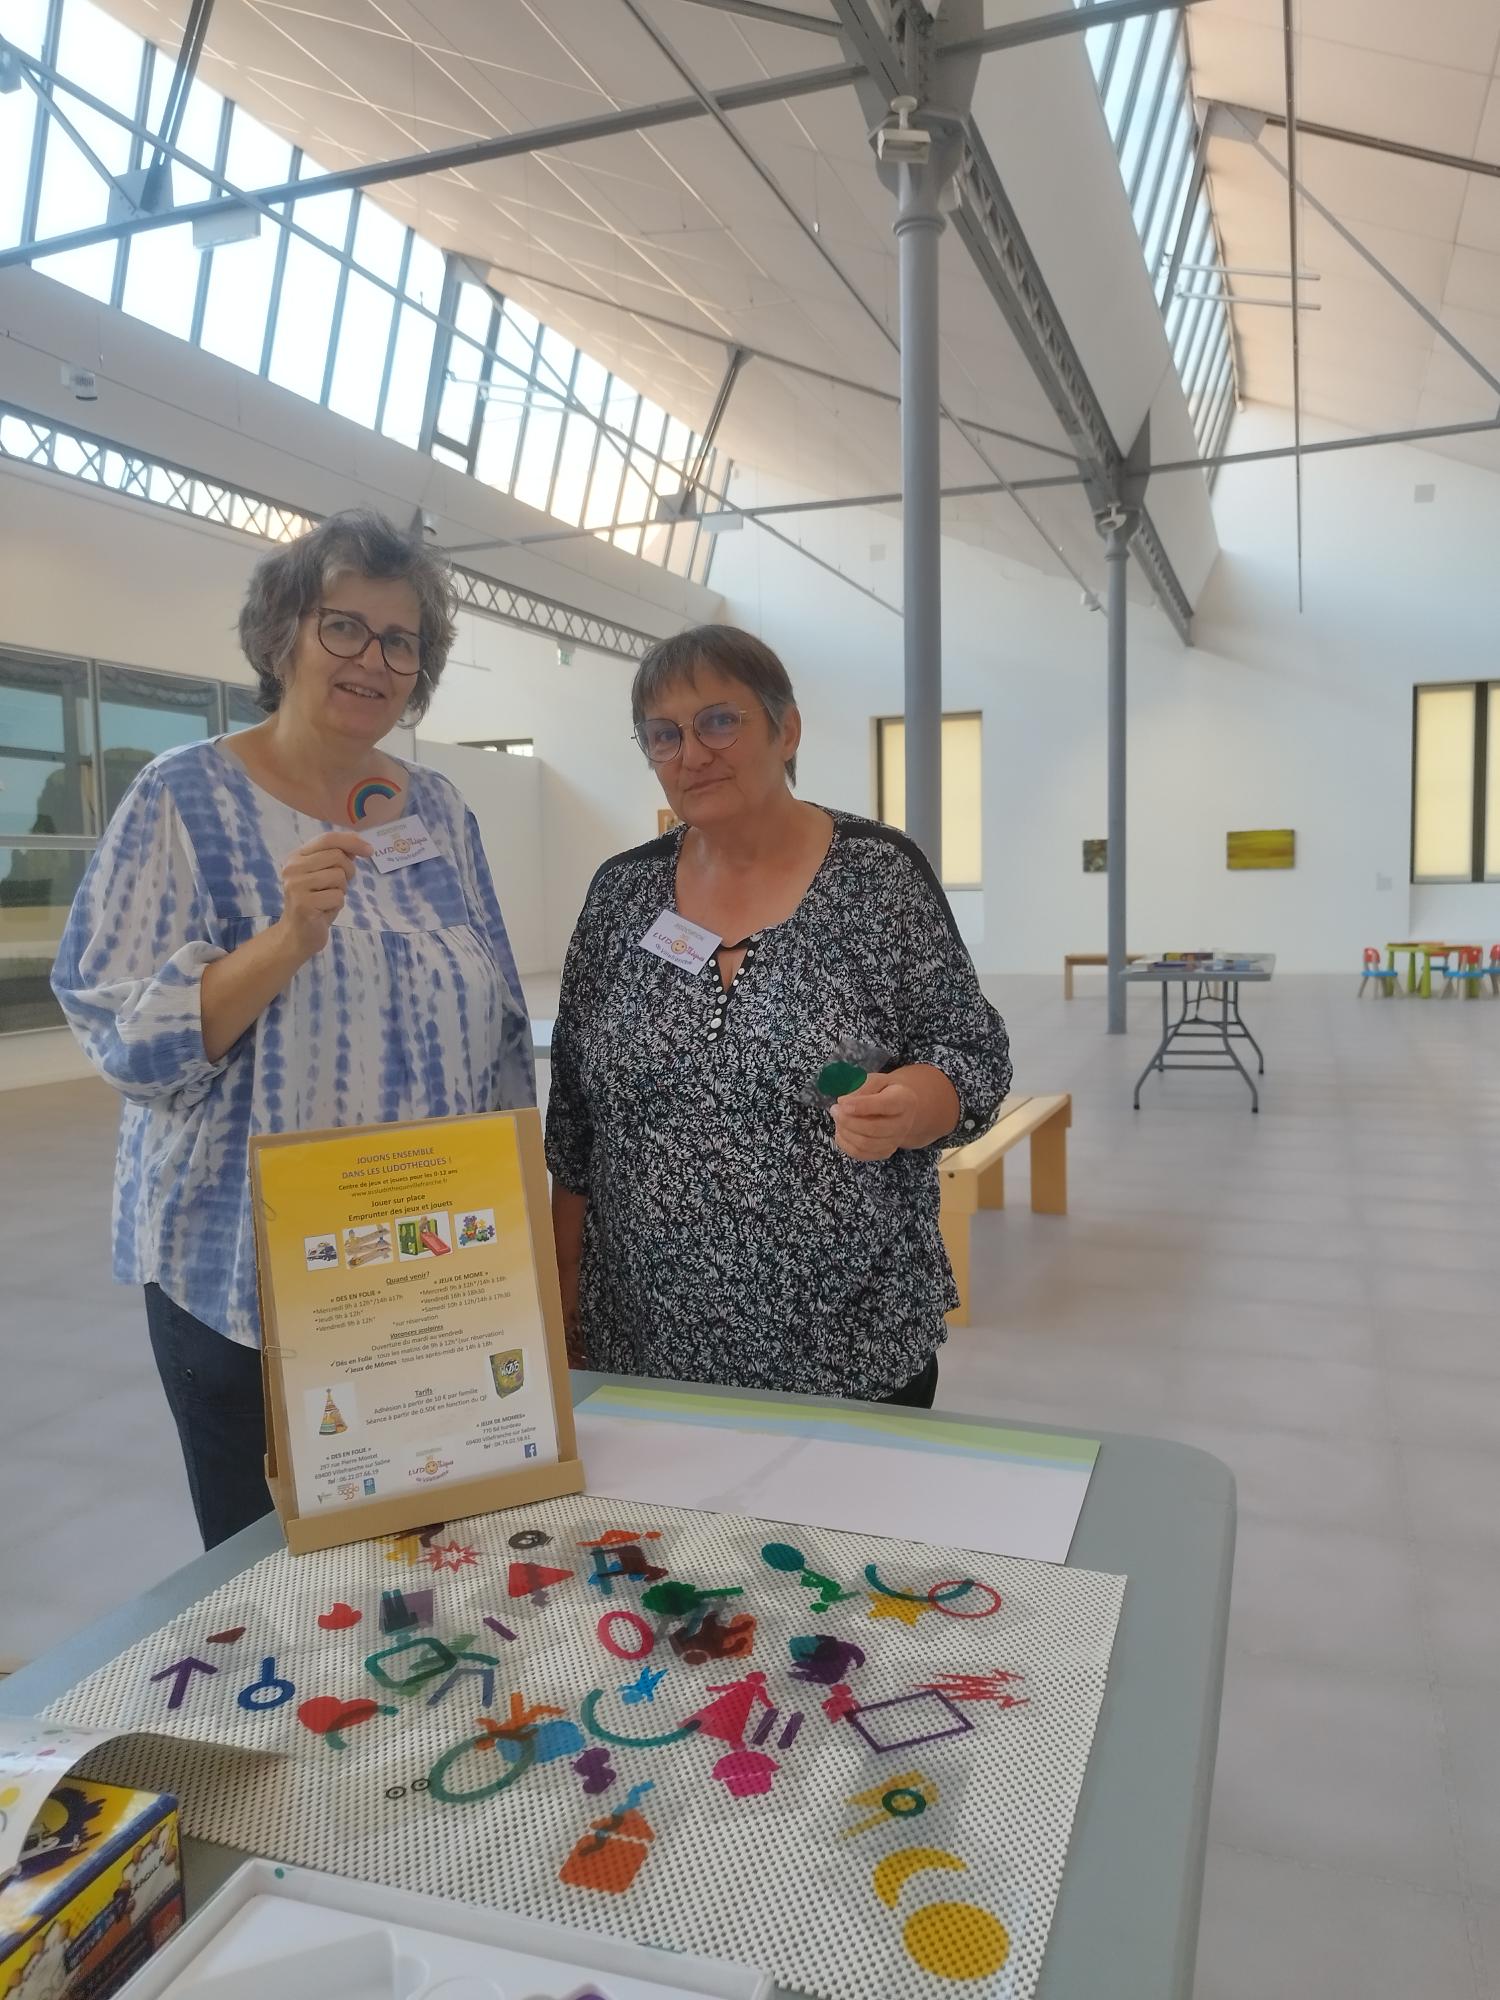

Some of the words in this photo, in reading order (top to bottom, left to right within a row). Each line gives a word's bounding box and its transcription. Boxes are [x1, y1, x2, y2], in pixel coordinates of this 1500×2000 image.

[357, 1154, 390, 1164] JOUONS
[392, 1147, 434, 1159] ENSEMBLE
[342, 1169, 365, 1179] DANS
[367, 1167, 380, 1176] LES
[382, 1158, 447, 1174] LUDOTHEQUES
[338, 1183, 358, 1191] Centre
[390, 1176, 408, 1184] jouets
[371, 1200, 391, 1208] Jouer
[406, 1194, 426, 1203] place
[348, 1211, 388, 1222] Emprunter
[390, 1208, 402, 1216] des
[404, 1205, 420, 1214] jeux
[430, 1200, 453, 1210] jouets
[386, 1275, 408, 1286] Quand
[359, 1290, 375, 1298] FOLIE
[422, 1286, 448, 1295] Mercredi
[424, 1294, 449, 1304] Vendredi
[316, 1304, 344, 1314] Mercredi
[425, 1303, 445, 1312] Samedi
[390, 1330, 417, 1340] Vacances
[418, 1324, 444, 1334] scolaires
[372, 1342, 401, 1351] Ouverture
[412, 1335, 428, 1344] mardi
[438, 1329, 463, 1338] vendredi
[350, 1366, 364, 1374] Jeux
[374, 1360, 398, 1369] Mômes
[414, 1387, 434, 1398] Tarifs
[374, 1404, 402, 1414] Adhésion
[408, 1400, 424, 1408] partir
[458, 1388, 478, 1398] famille
[366, 1417, 388, 1426] Séance
[393, 1411, 410, 1420] partir
[446, 1399, 470, 1408] fonction
